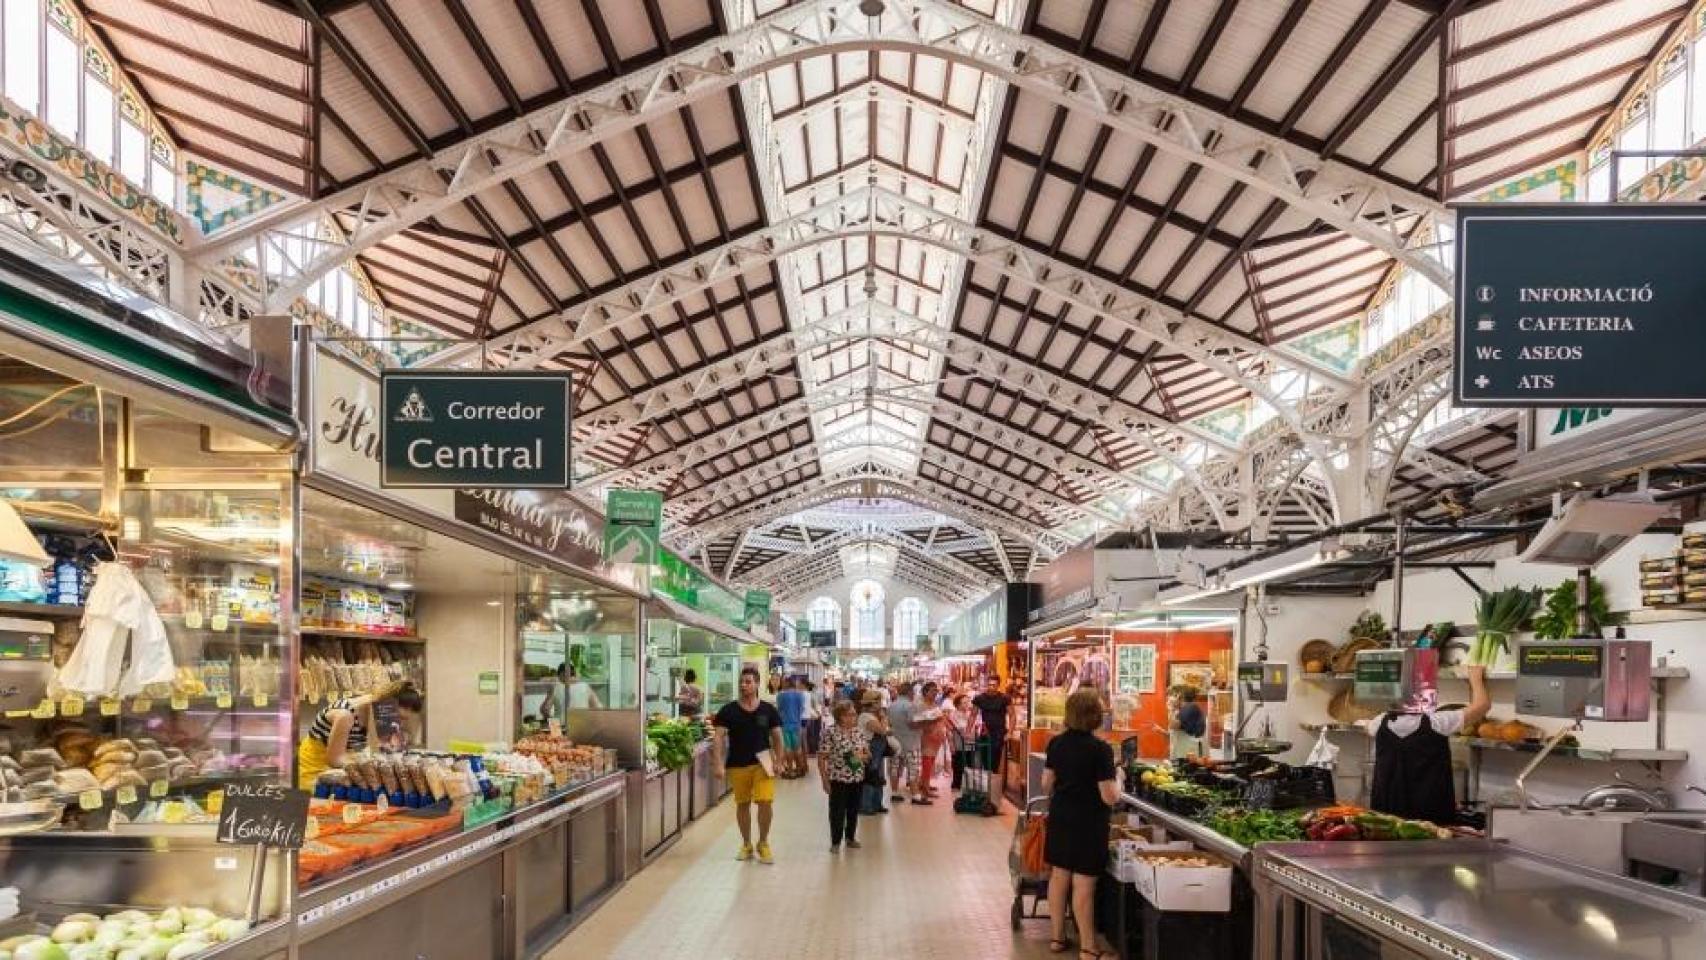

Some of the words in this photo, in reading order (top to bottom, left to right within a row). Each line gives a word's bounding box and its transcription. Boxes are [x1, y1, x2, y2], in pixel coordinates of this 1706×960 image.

[1520, 284, 1652, 301] INFORMACIÓ
[1519, 317, 1633, 330] CAFETERIA
[1477, 347, 1500, 359] Wc
[1519, 346, 1582, 359] ASEOS
[1518, 375, 1554, 388] ATS
[448, 402, 544, 419] Corredor
[322, 397, 382, 462] Hu
[408, 439, 541, 469] Central
[226, 783, 285, 800] DULCES
[219, 807, 237, 843] 1
